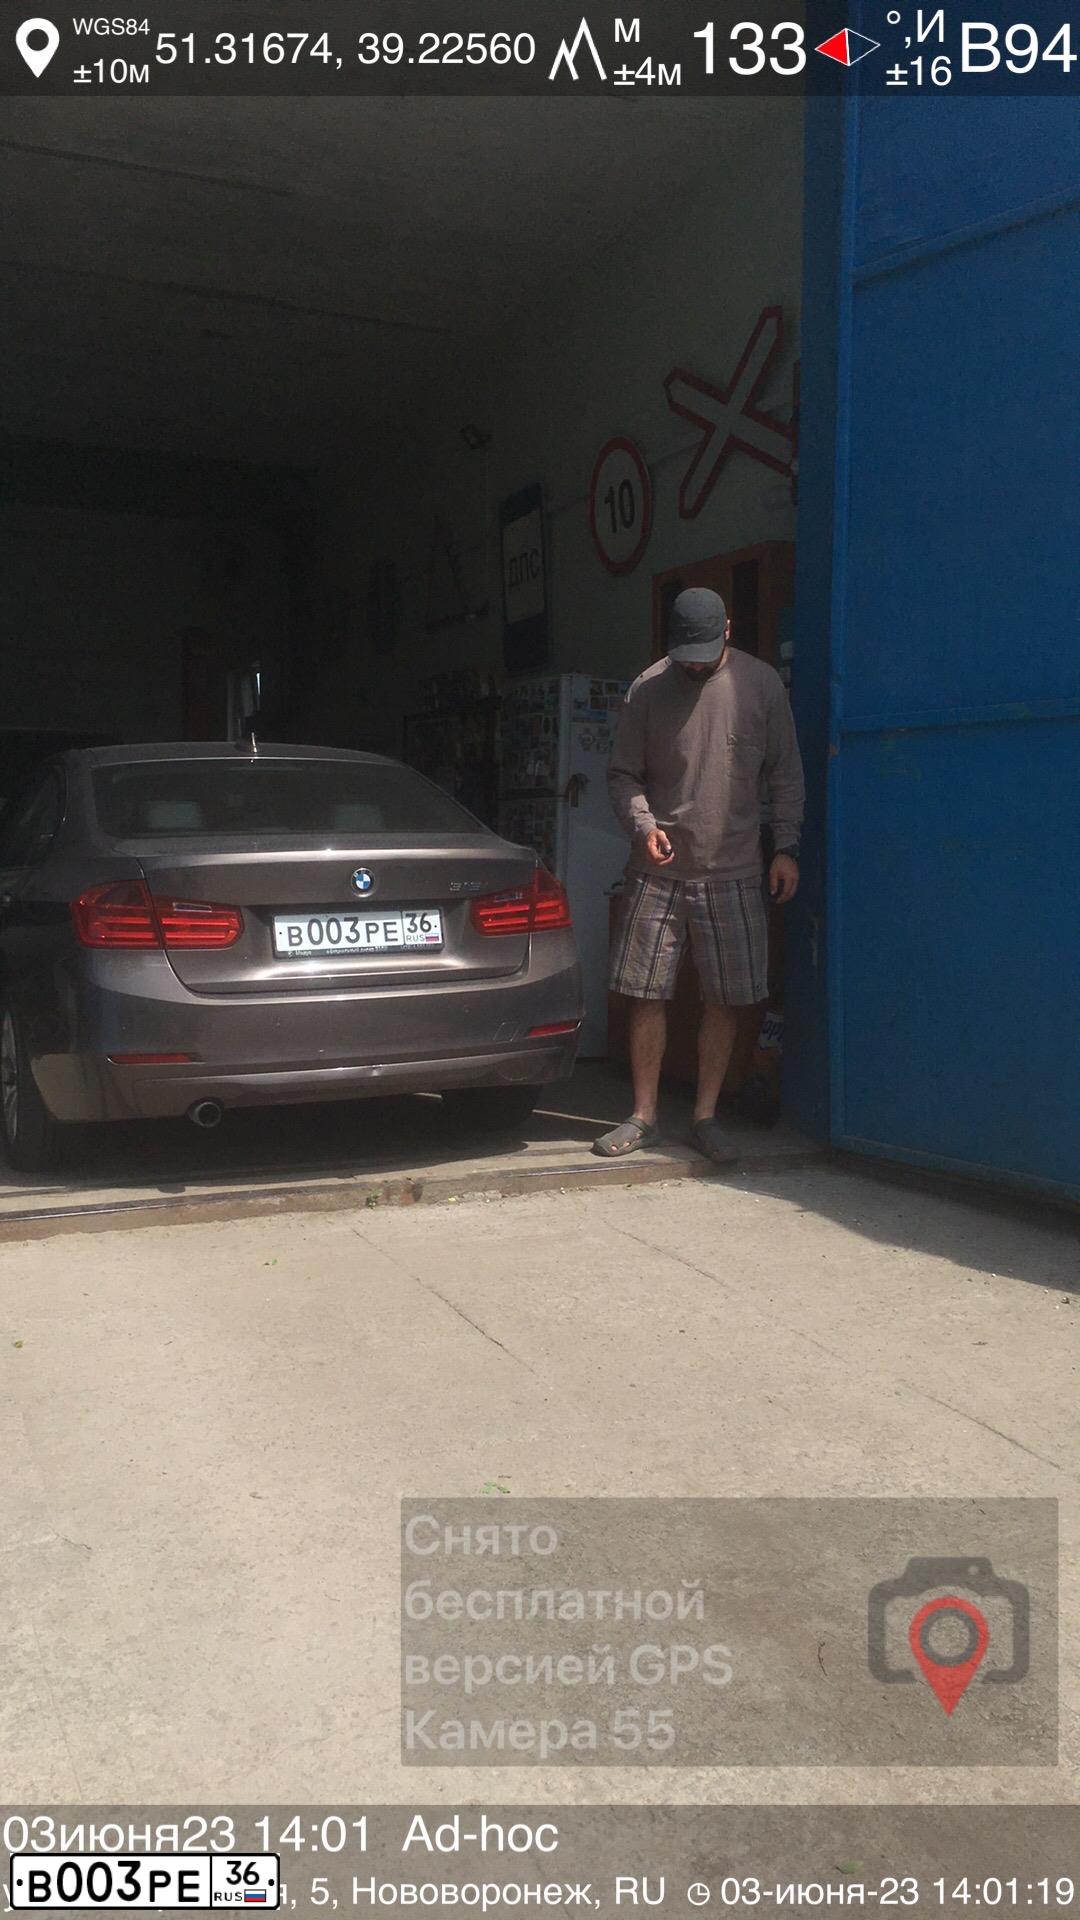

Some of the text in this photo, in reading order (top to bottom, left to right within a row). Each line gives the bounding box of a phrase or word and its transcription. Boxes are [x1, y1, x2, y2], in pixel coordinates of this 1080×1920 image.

[604, 479, 635, 533] 10
[508, 548, 541, 588] ДПС
[405, 911, 432, 934] 36
[405, 933, 425, 943] RUS
